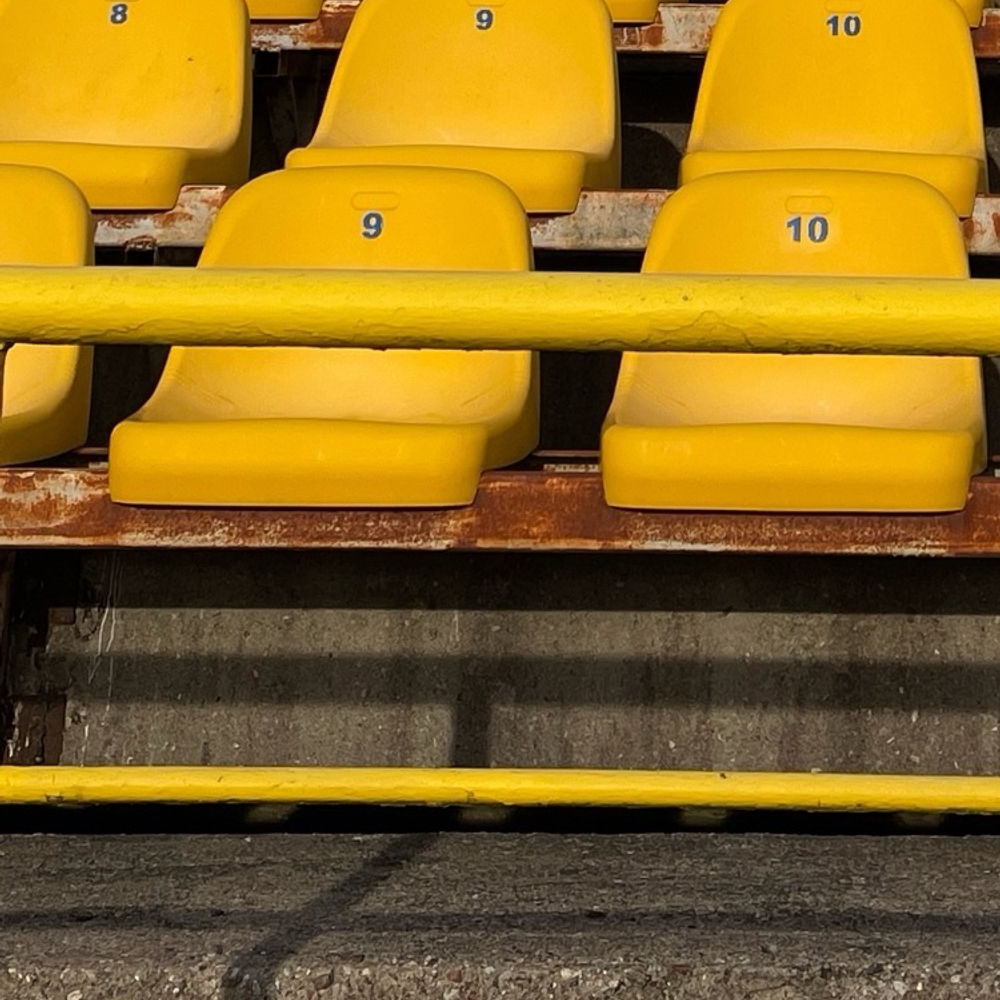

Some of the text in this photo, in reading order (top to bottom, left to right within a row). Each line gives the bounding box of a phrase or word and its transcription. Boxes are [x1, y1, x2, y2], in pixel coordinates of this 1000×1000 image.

[110, 0, 128, 24] 8
[476, 9, 493, 30] 9
[826, 15, 861, 37] 10
[362, 212, 384, 239] 9
[787, 216, 828, 243] 10
